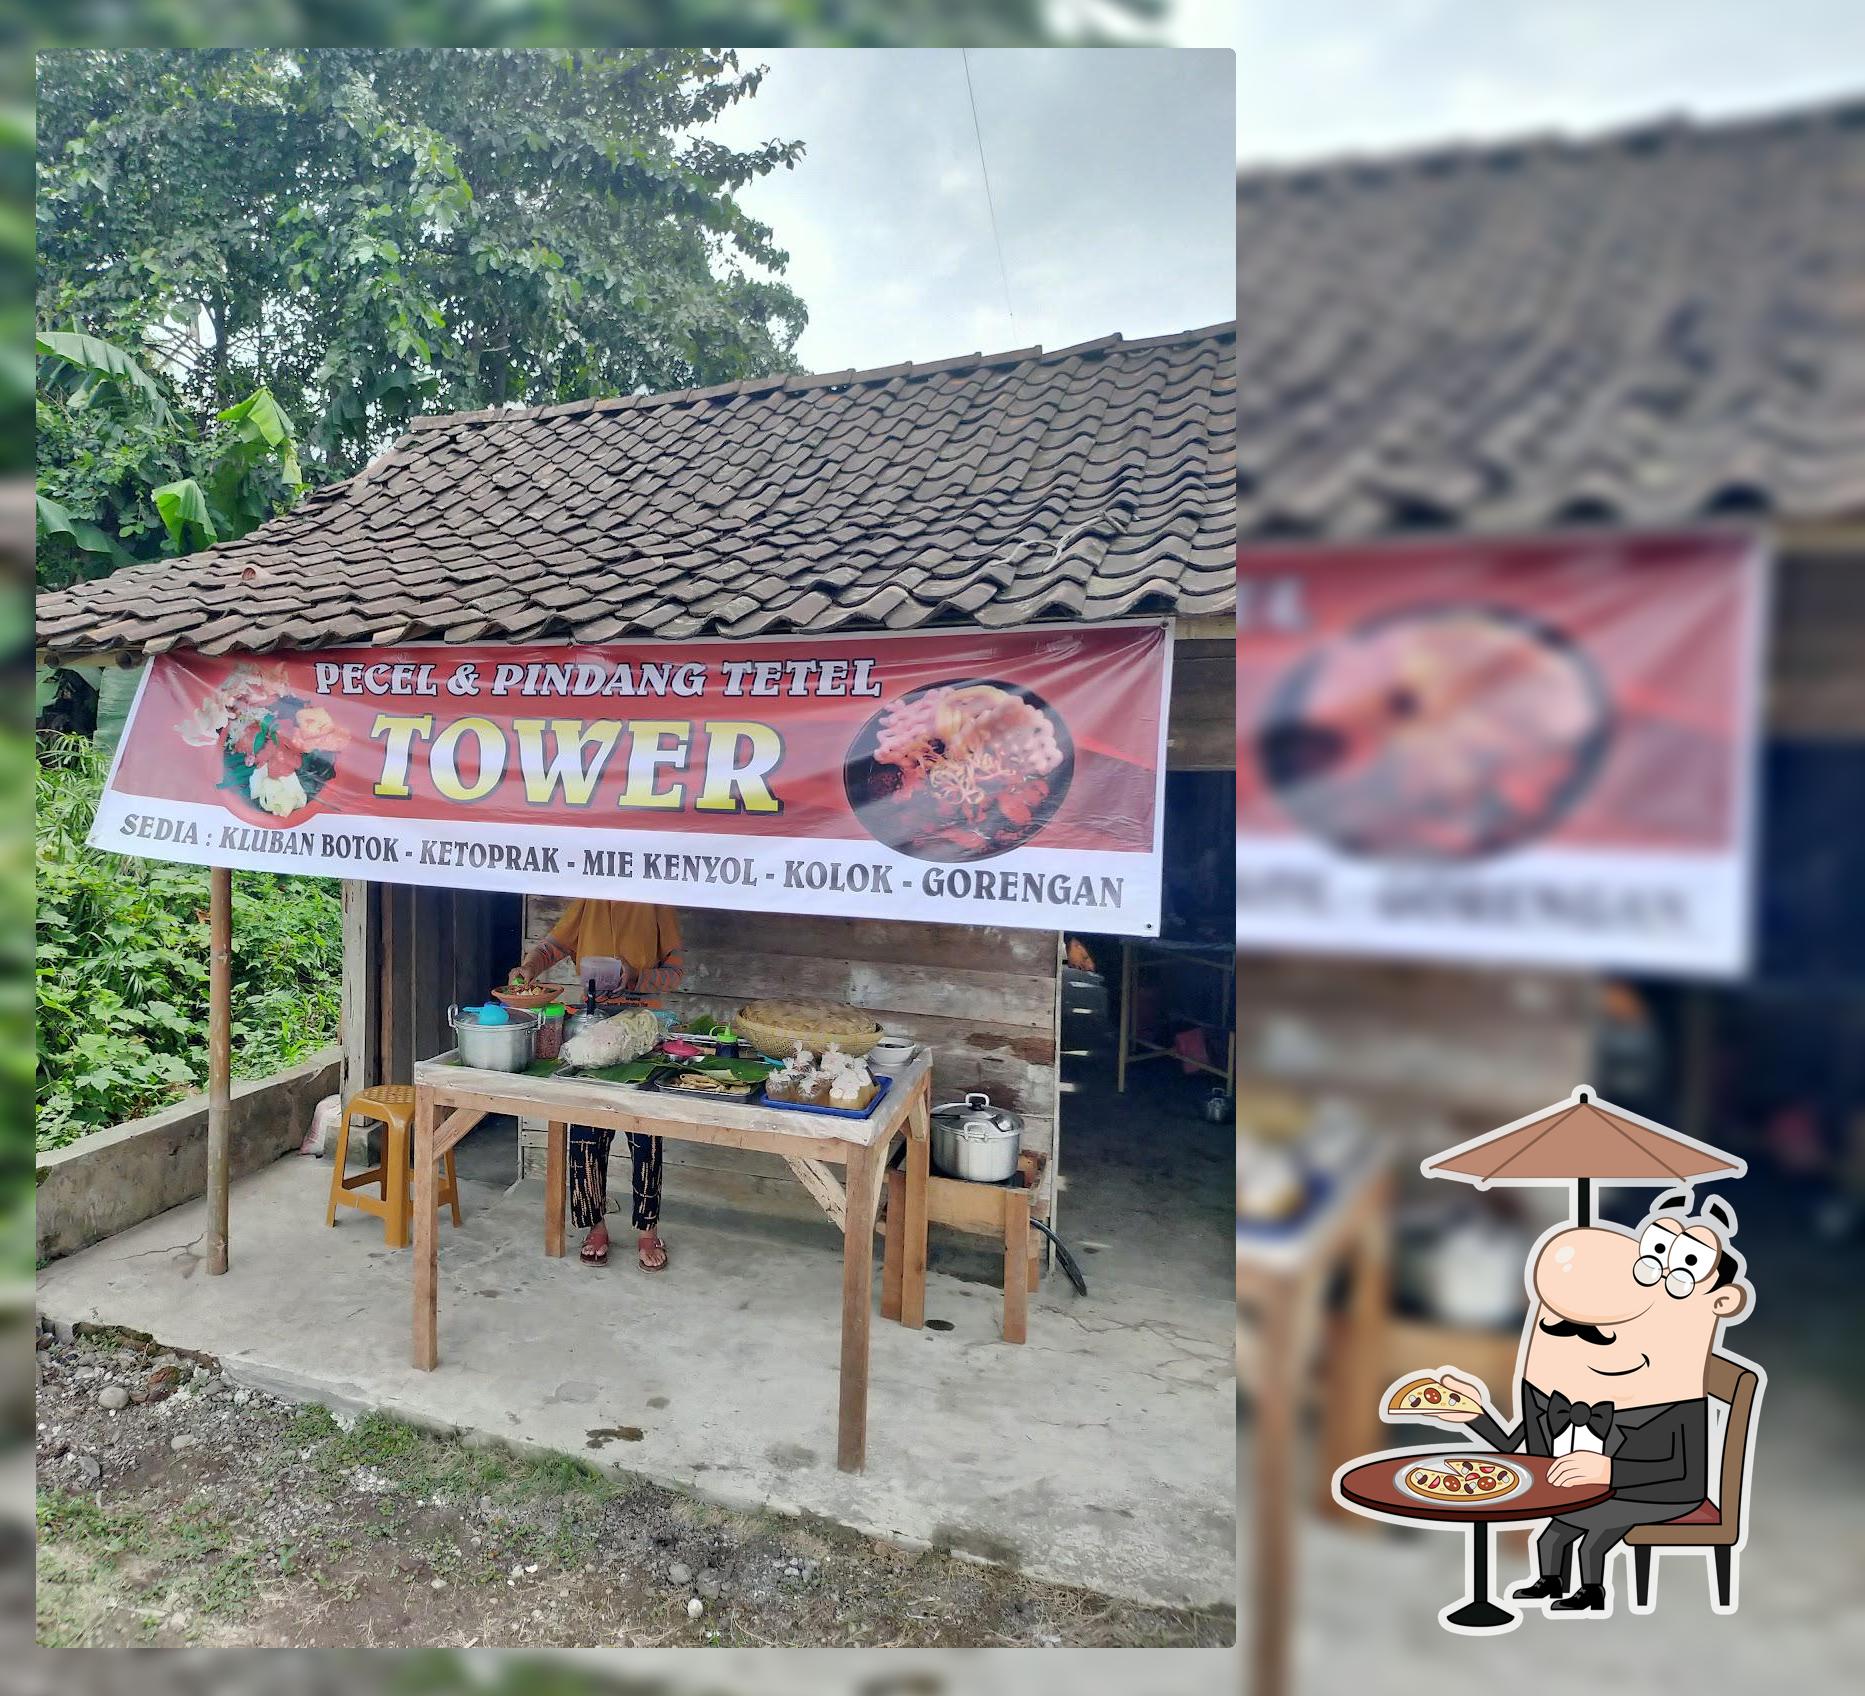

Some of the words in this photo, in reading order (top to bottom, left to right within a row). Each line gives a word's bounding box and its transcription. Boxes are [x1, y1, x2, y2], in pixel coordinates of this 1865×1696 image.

[315, 661, 438, 697] PECEL
[446, 663, 480, 696] &
[491, 661, 706, 697] PINDANG
[720, 659, 882, 698] TETEL
[371, 713, 783, 813] TOWER
[119, 813, 198, 845] SEDIA
[218, 826, 315, 857] KLUBAN
[320, 833, 399, 862] BOTOK
[419, 840, 560, 874] KETOPRAK
[582, 849, 633, 878] MIE
[643, 852, 757, 887] KENYOL
[783, 860, 893, 894] KOLOK
[922, 867, 1125, 909] GORENGAN
